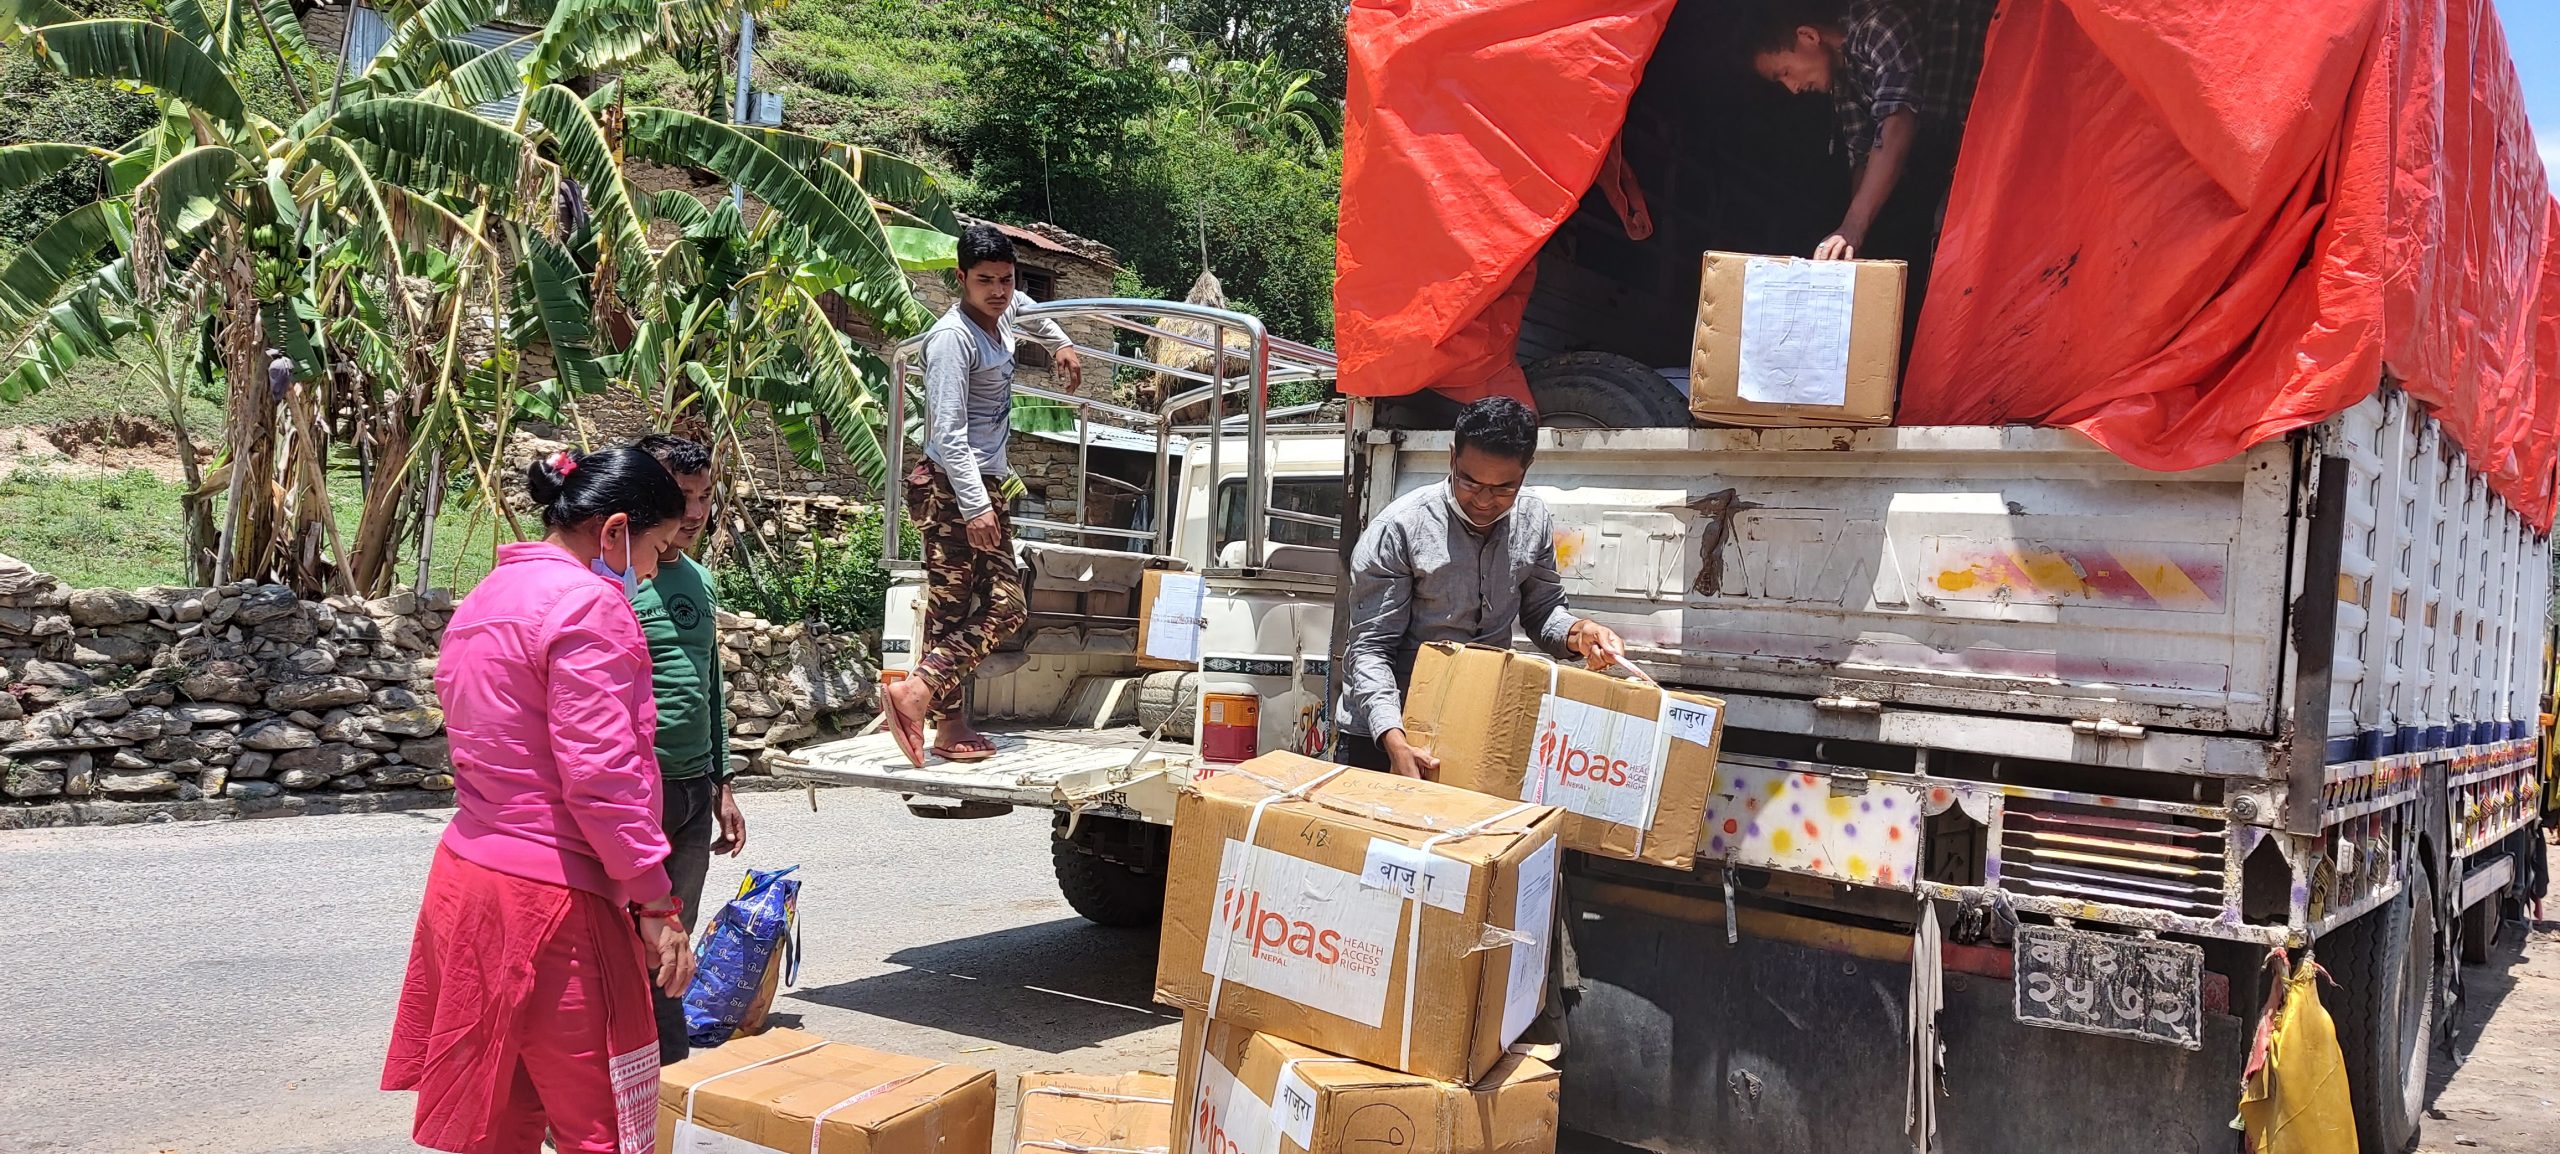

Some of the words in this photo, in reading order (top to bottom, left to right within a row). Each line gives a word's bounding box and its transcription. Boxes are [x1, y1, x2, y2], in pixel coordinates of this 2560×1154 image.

[1669, 707, 1707, 728] बाजुरा
[1627, 773, 1648, 784] ACCE
[1380, 861, 1435, 894] बाजुा
[1344, 936, 1384, 957] HEALTH
[1260, 952, 1288, 967] NEPAL
[1341, 948, 1380, 966] ACCESS
[1339, 959, 1377, 977] RIGHTS
